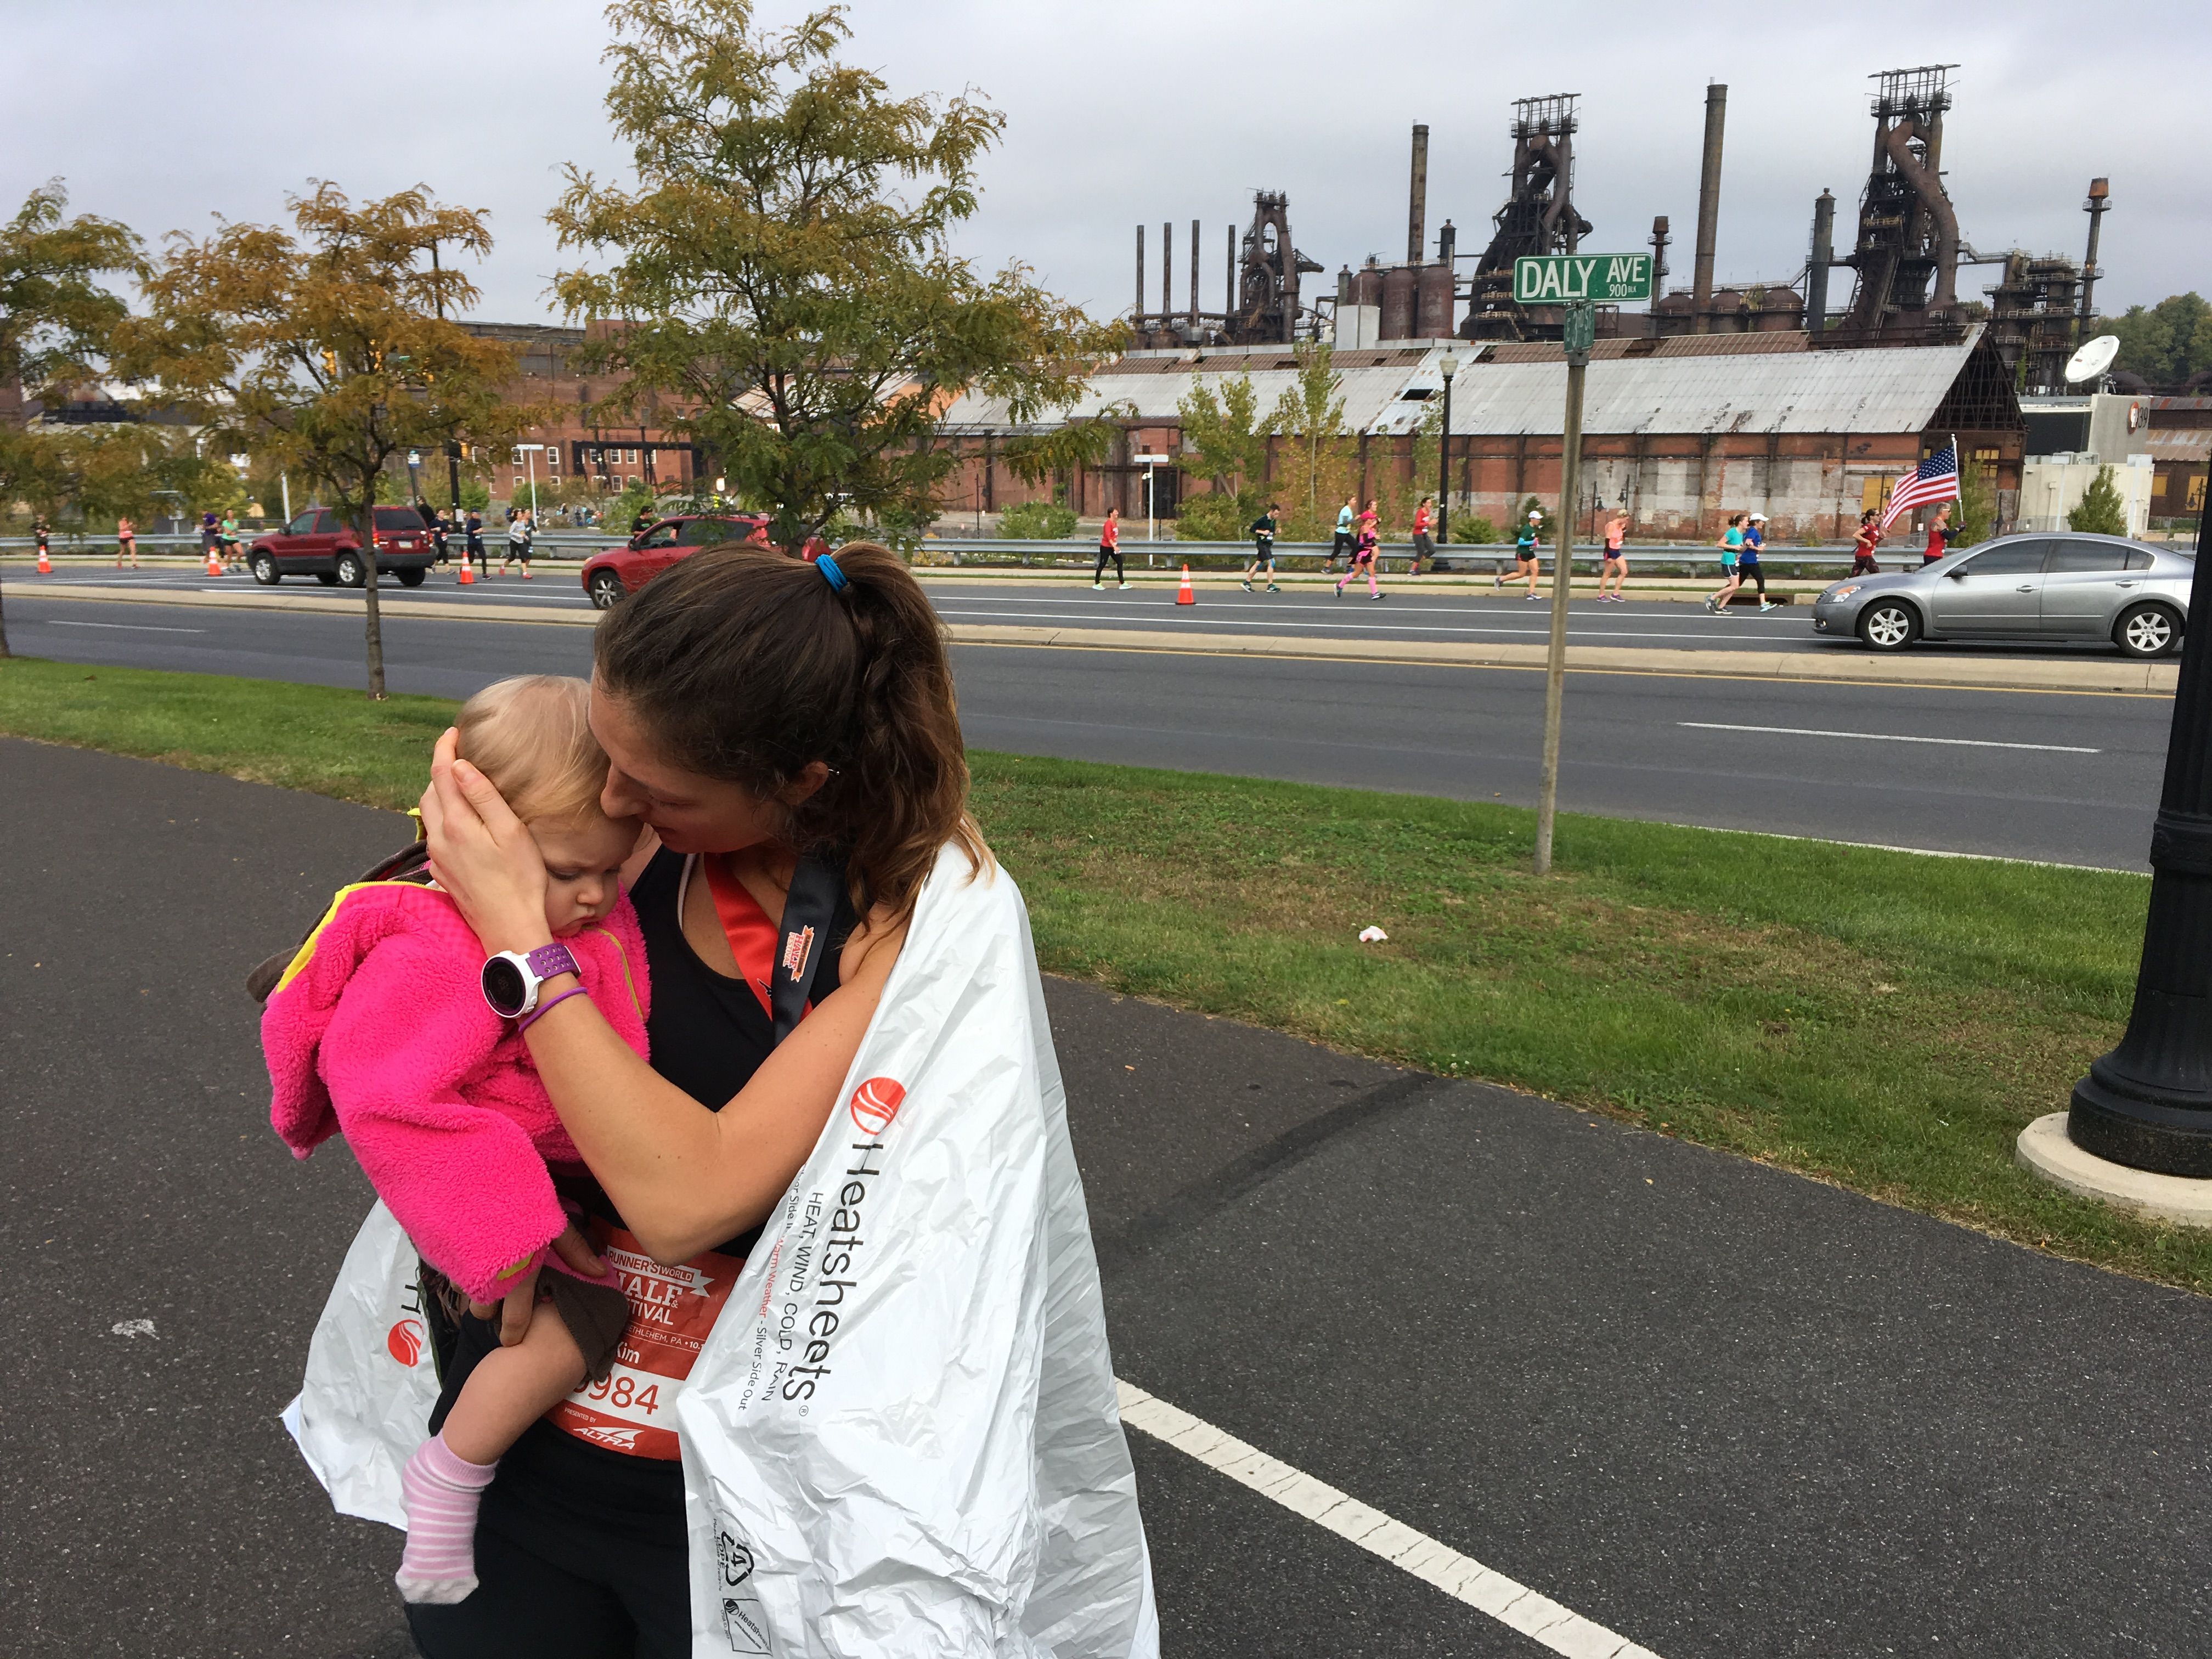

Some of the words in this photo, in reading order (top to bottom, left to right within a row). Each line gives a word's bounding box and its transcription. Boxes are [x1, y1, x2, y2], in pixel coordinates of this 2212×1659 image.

[1521, 259, 1596, 298] DALY
[1606, 257, 1646, 283] AVE
[1609, 284, 1627, 297] 900
[1628, 285, 1637, 294] BLK
[2138, 407, 2148, 428] 39
[788, 1195, 799, 1220] Side
[799, 1192, 823, 1239] HEAT,
[608, 1250, 659, 1274] RUNNER'S
[662, 1266, 692, 1281] WORLD
[782, 1143, 884, 1402] Heatsheets
[785, 1246, 812, 1295] WIND,
[759, 1271, 776, 1318] Weather
[629, 1299, 674, 1326] TIVAL
[776, 1302, 798, 1354] COLD,
[627, 1325, 669, 1344] ETHLEHEM,
[670, 1336, 682, 1345] PA
[754, 1327, 767, 1360] Silver
[748, 1362, 761, 1386] Side
[761, 1362, 788, 1401] RAIN
[564, 1407, 589, 1421] PRESENTED
[738, 1389, 753, 1410] Out
[573, 1427, 635, 1450] ALTRA
[716, 1536, 725, 1569] LDPE
[731, 1551, 747, 1567] 4
[738, 1611, 770, 1651] Heatshee
